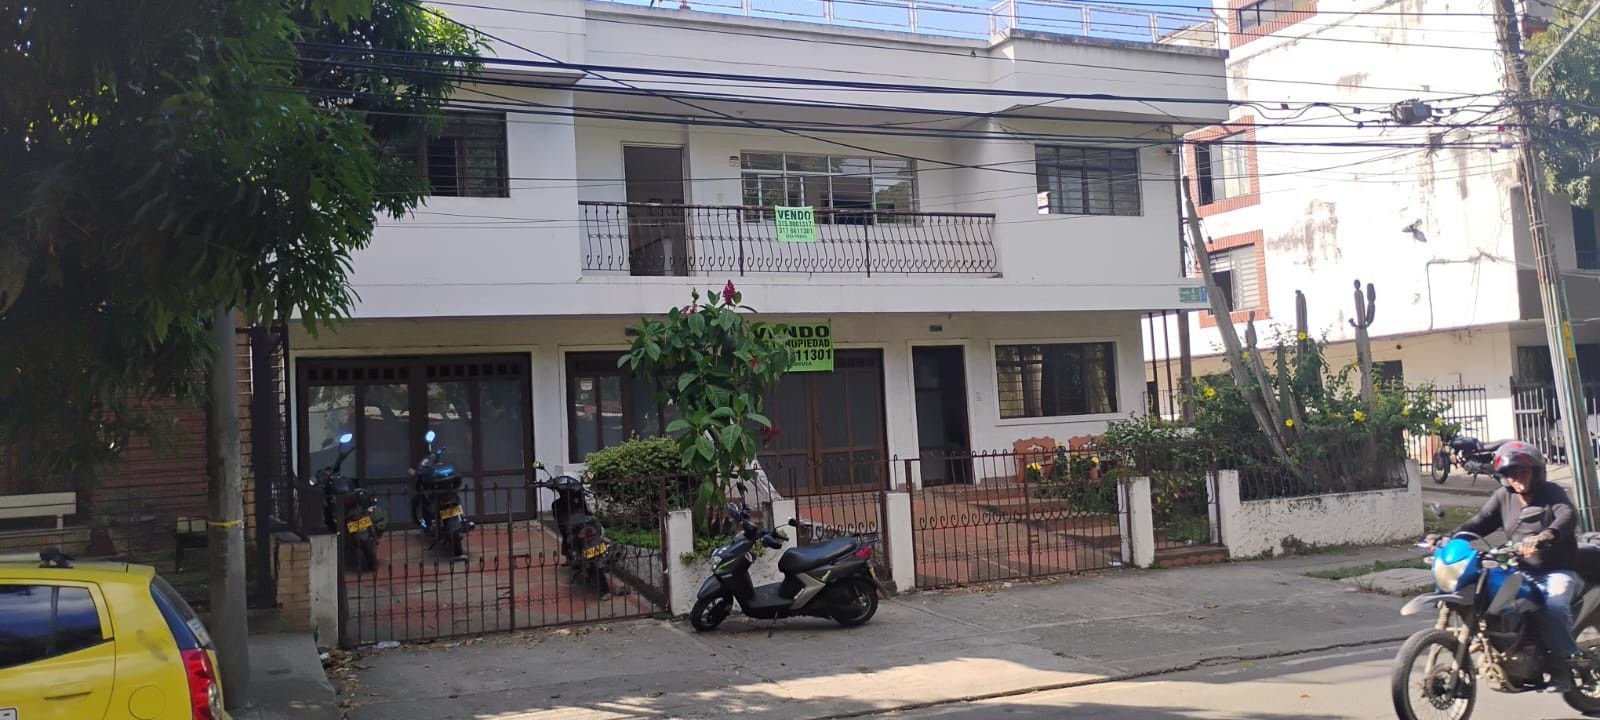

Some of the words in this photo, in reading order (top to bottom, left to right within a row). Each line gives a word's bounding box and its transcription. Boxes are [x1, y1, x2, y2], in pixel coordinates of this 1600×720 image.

[777, 210, 811, 220] VENDO
[753, 326, 830, 339] VNDO
[785, 339, 830, 348] ROPIEDAD
[796, 348, 831, 361] 11301
